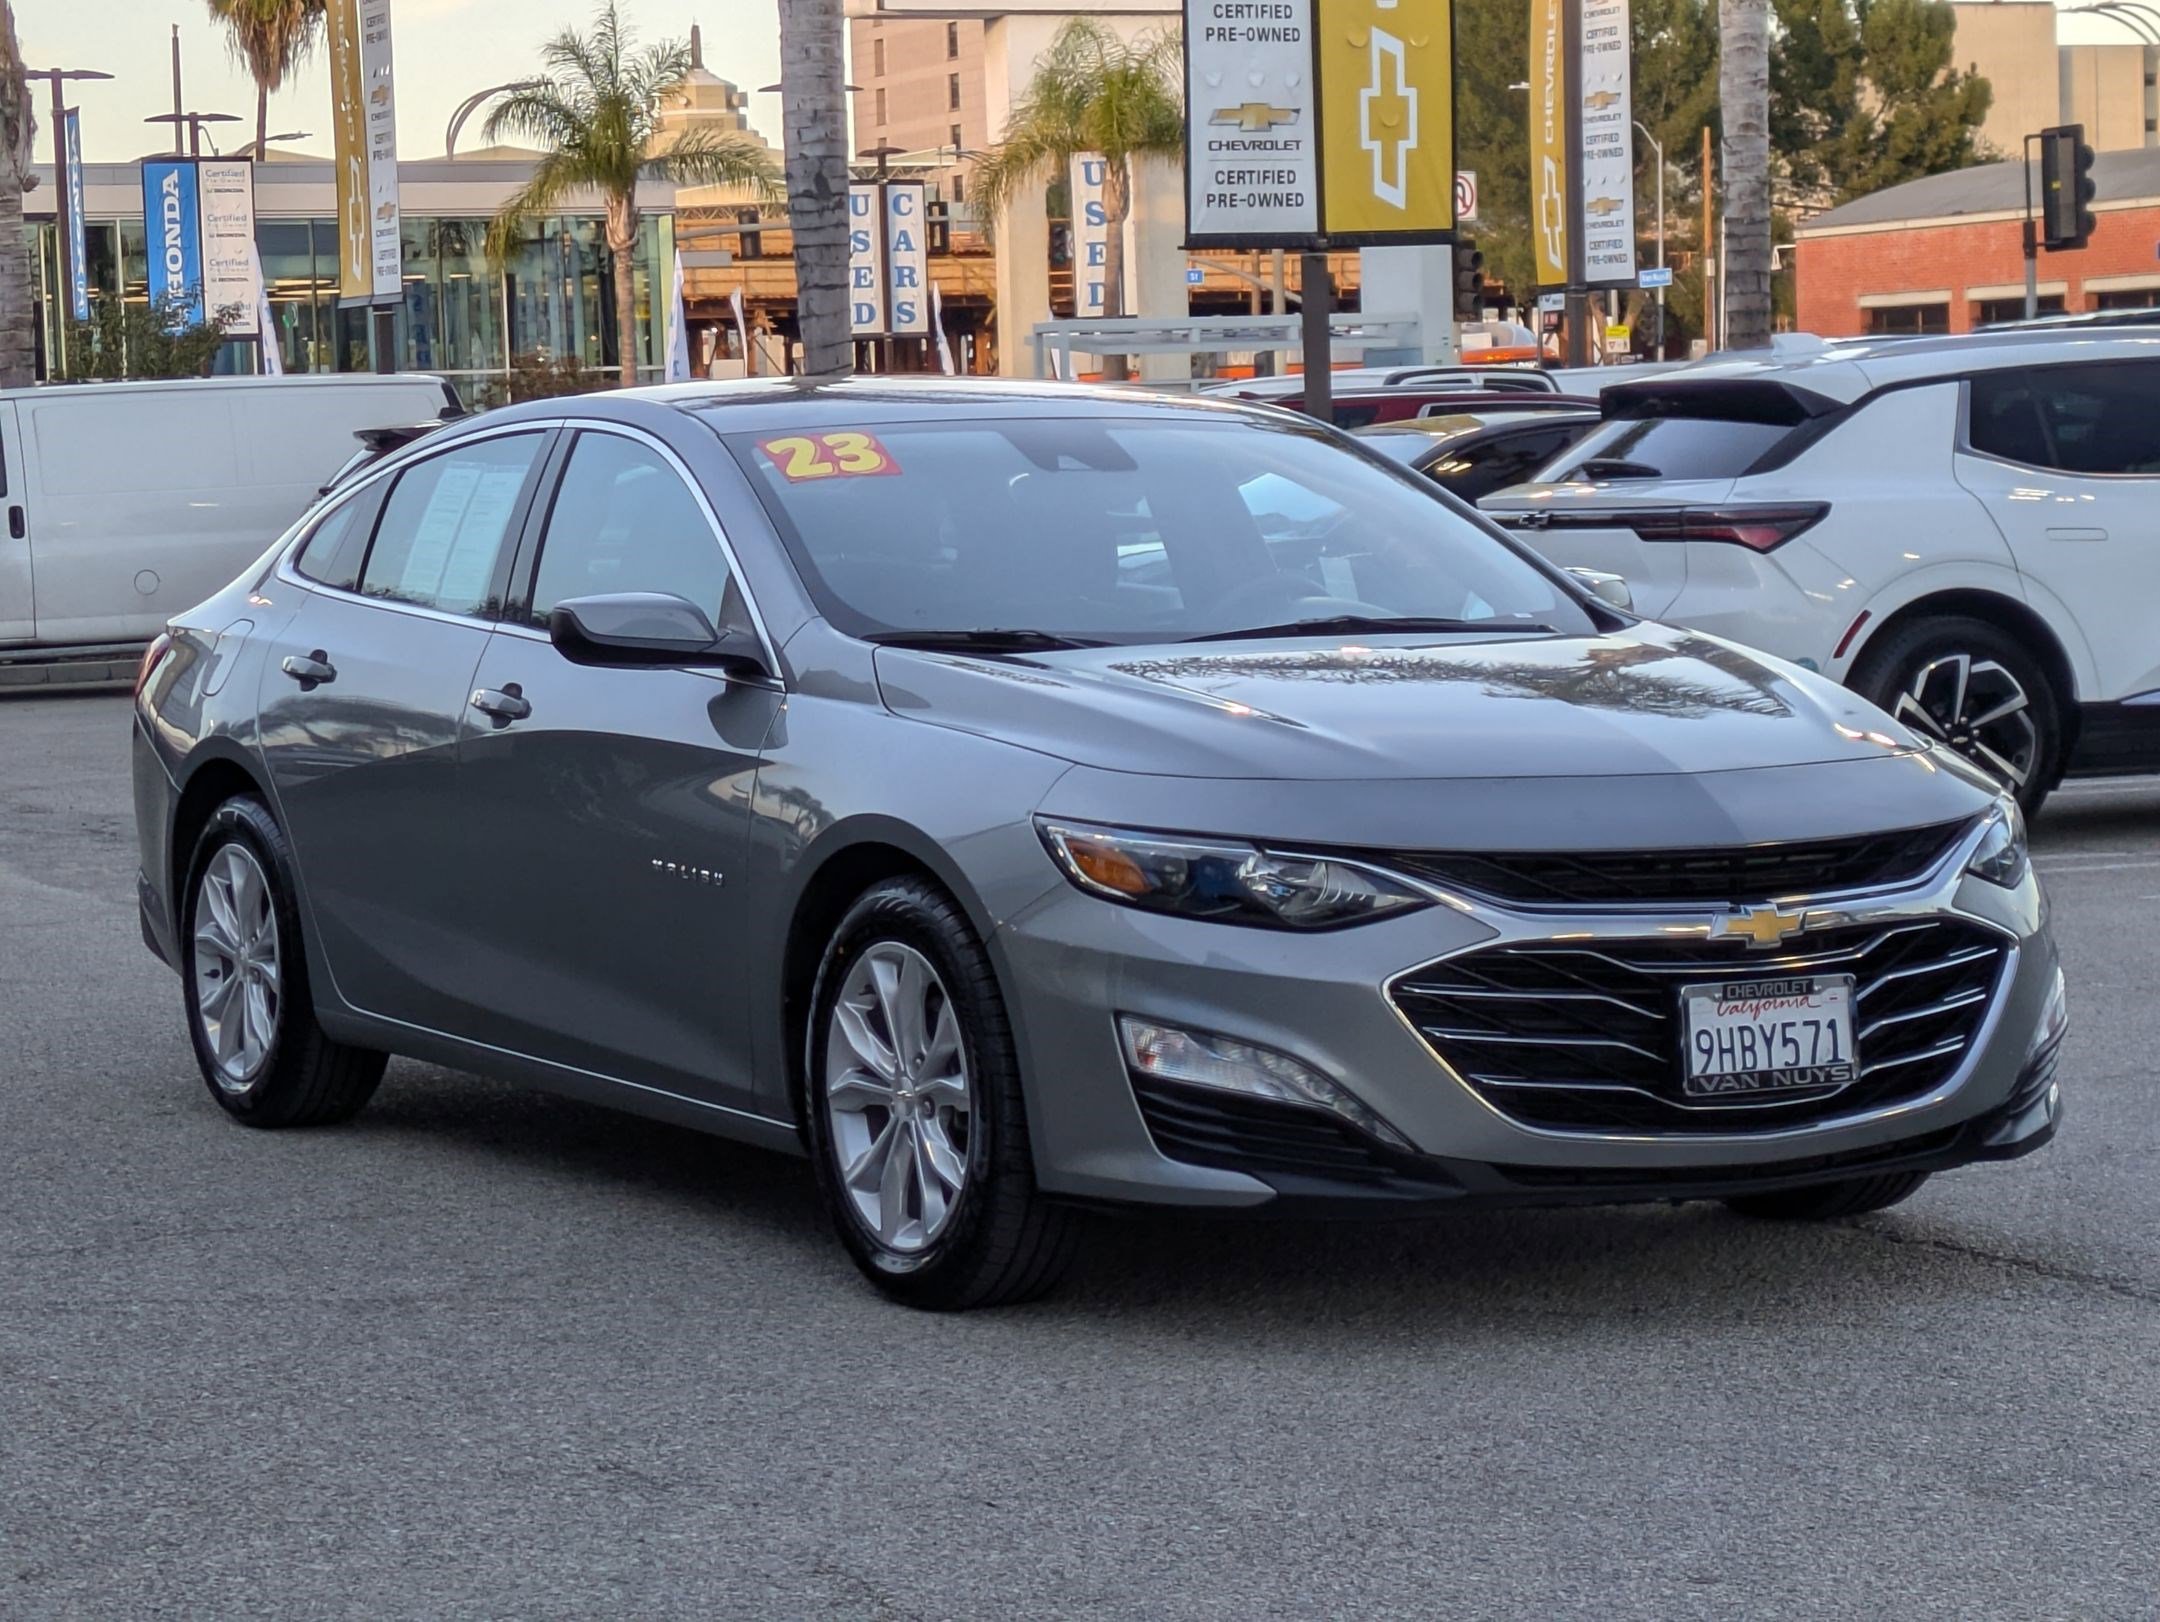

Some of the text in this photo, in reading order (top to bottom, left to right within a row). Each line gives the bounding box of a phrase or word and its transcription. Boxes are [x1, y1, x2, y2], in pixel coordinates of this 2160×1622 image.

[1213, 3, 1293, 19] CERTIFIED
[1205, 26, 1301, 42] PRE-OWNED
[1208, 139, 1302, 152] CHEVROLET
[1215, 169, 1296, 185] CERTIFIED
[1206, 192, 1304, 208] PRE-OWNED
[162, 169, 184, 299] HONDA
[849, 194, 876, 325] USED
[892, 193, 919, 324] CARS
[766, 432, 886, 478] 23
[1726, 980, 1810, 999] CHEVROLET
[1717, 995, 1821, 1021] California
[1696, 1018, 1846, 1075] 9HBY571
[1701, 1064, 1850, 1092] VAN NUYS
